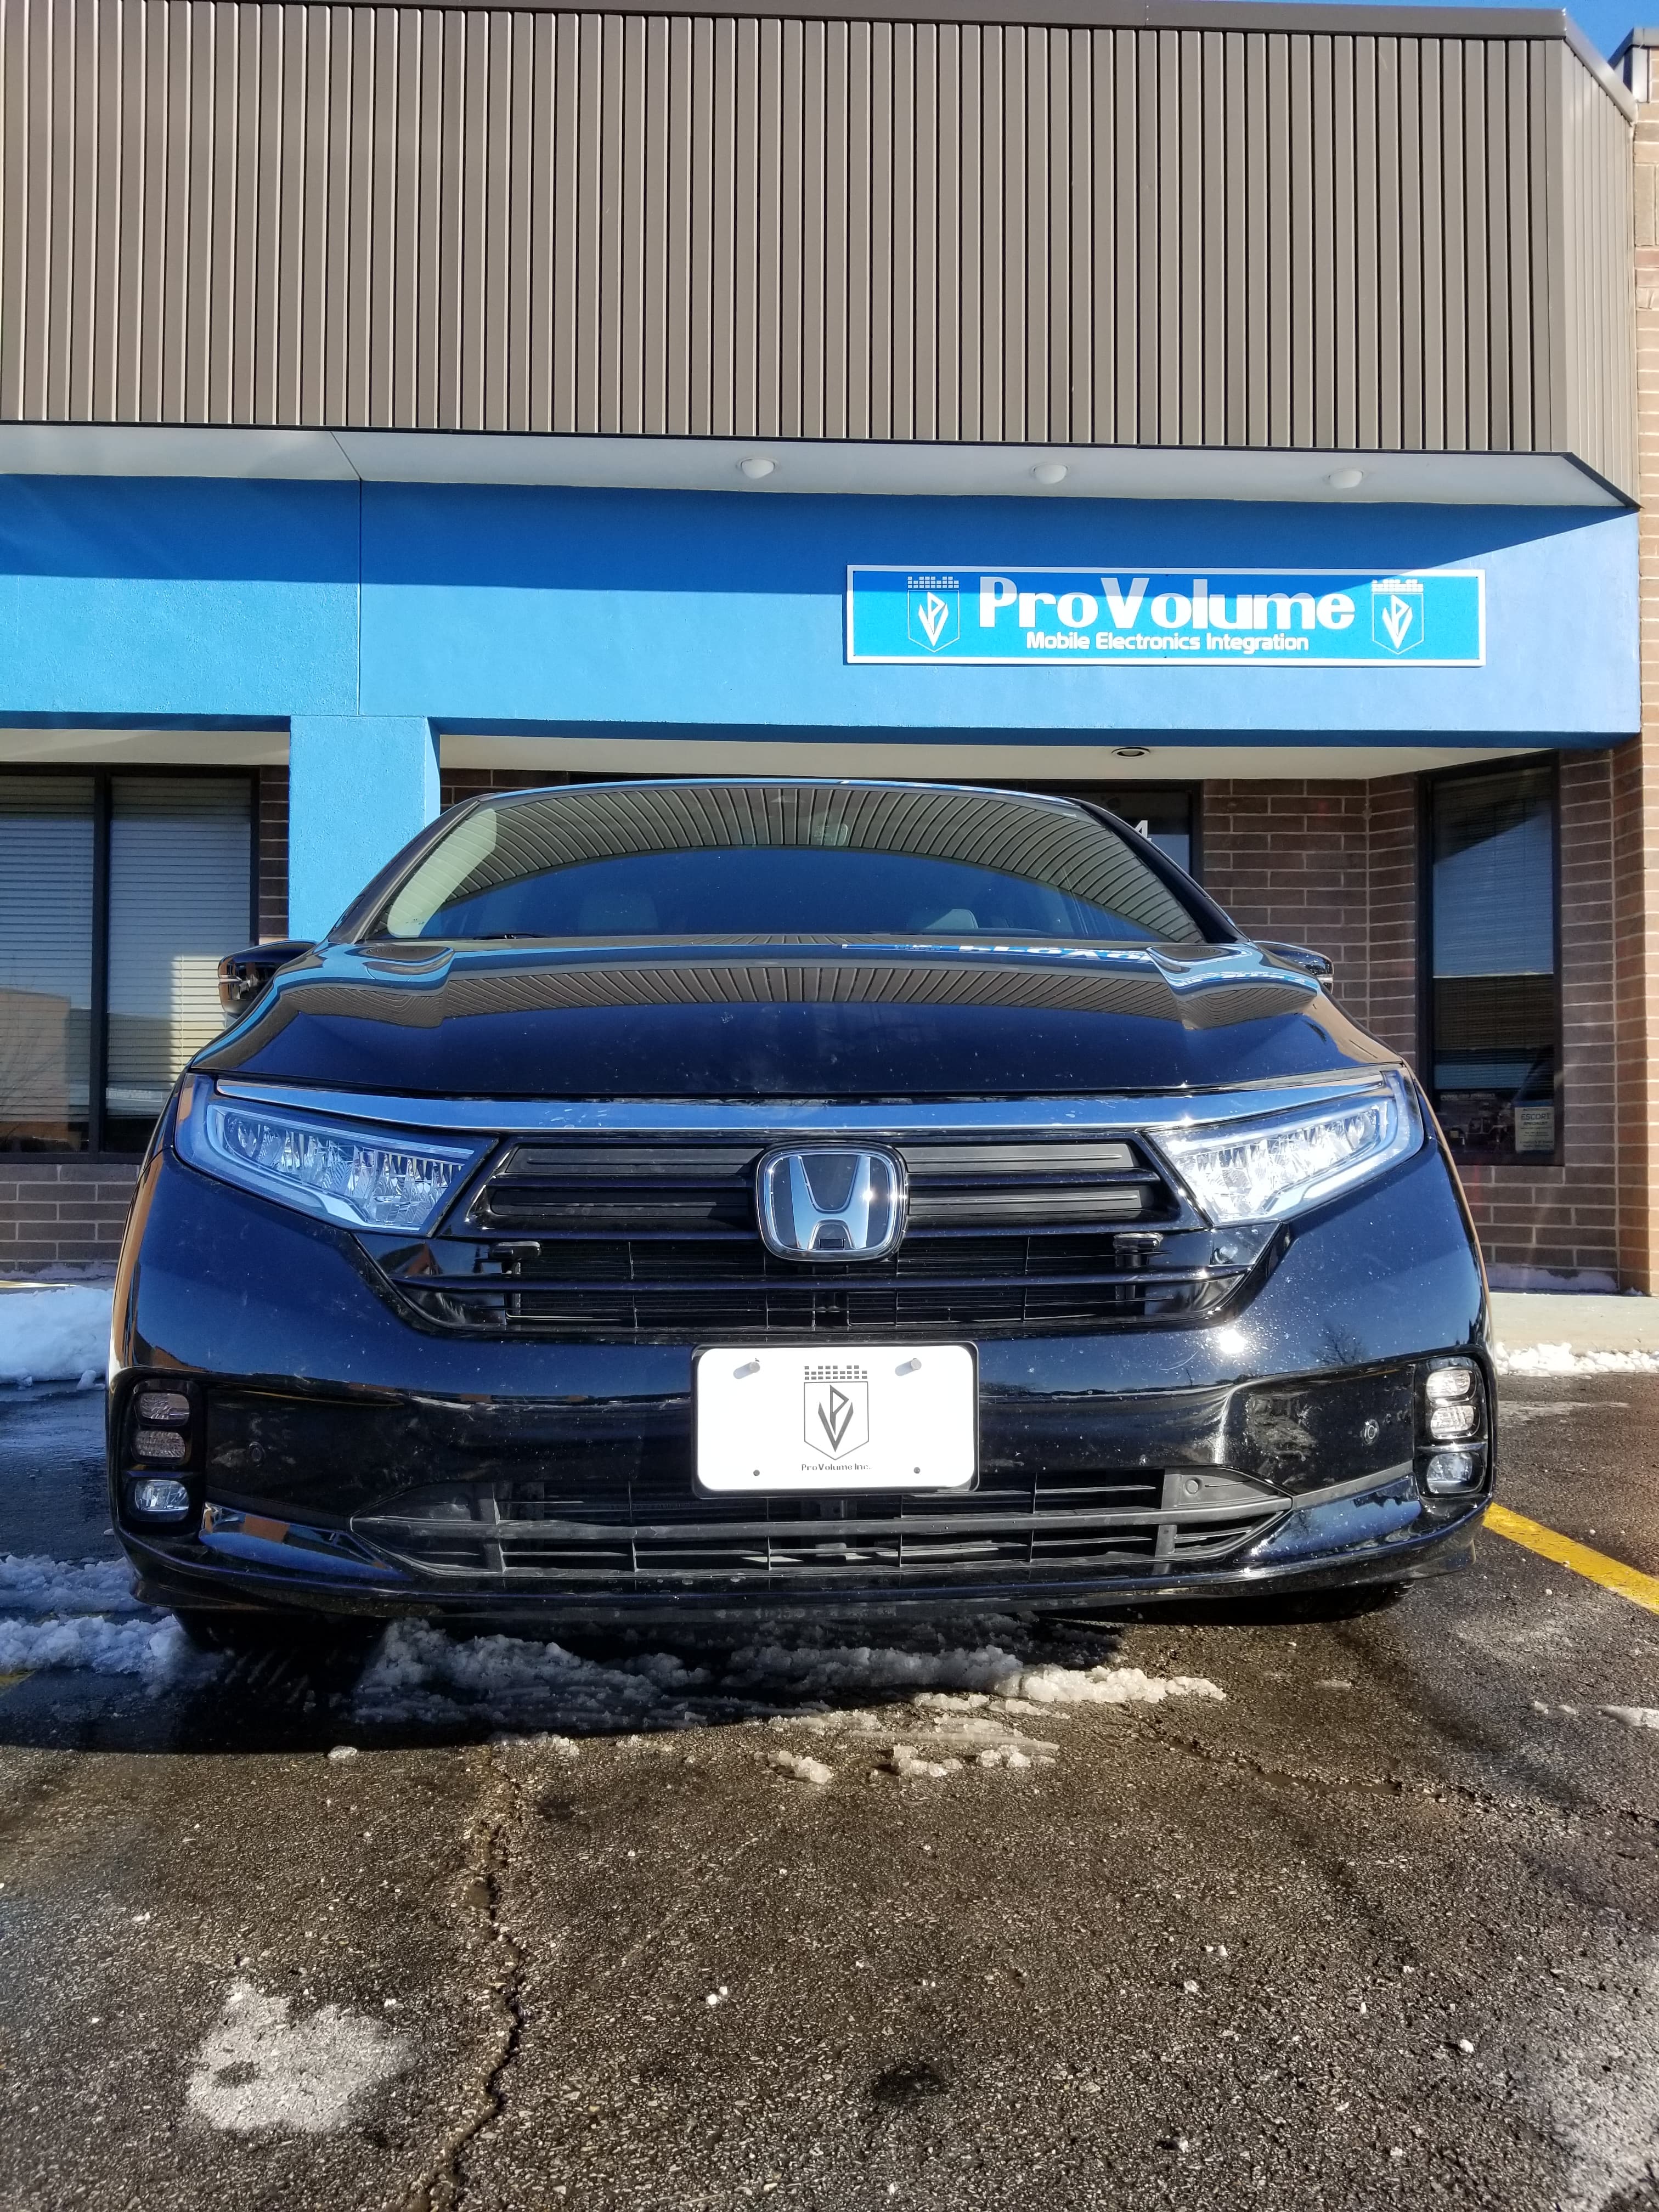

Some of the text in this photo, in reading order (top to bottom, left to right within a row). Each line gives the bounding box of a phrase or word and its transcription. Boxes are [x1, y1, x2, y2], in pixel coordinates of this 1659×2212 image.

[979, 576, 1356, 629] ProVolume
[1026, 631, 1309, 654] Mobile Electronics Integration
[1135, 820, 1152, 841] 4
